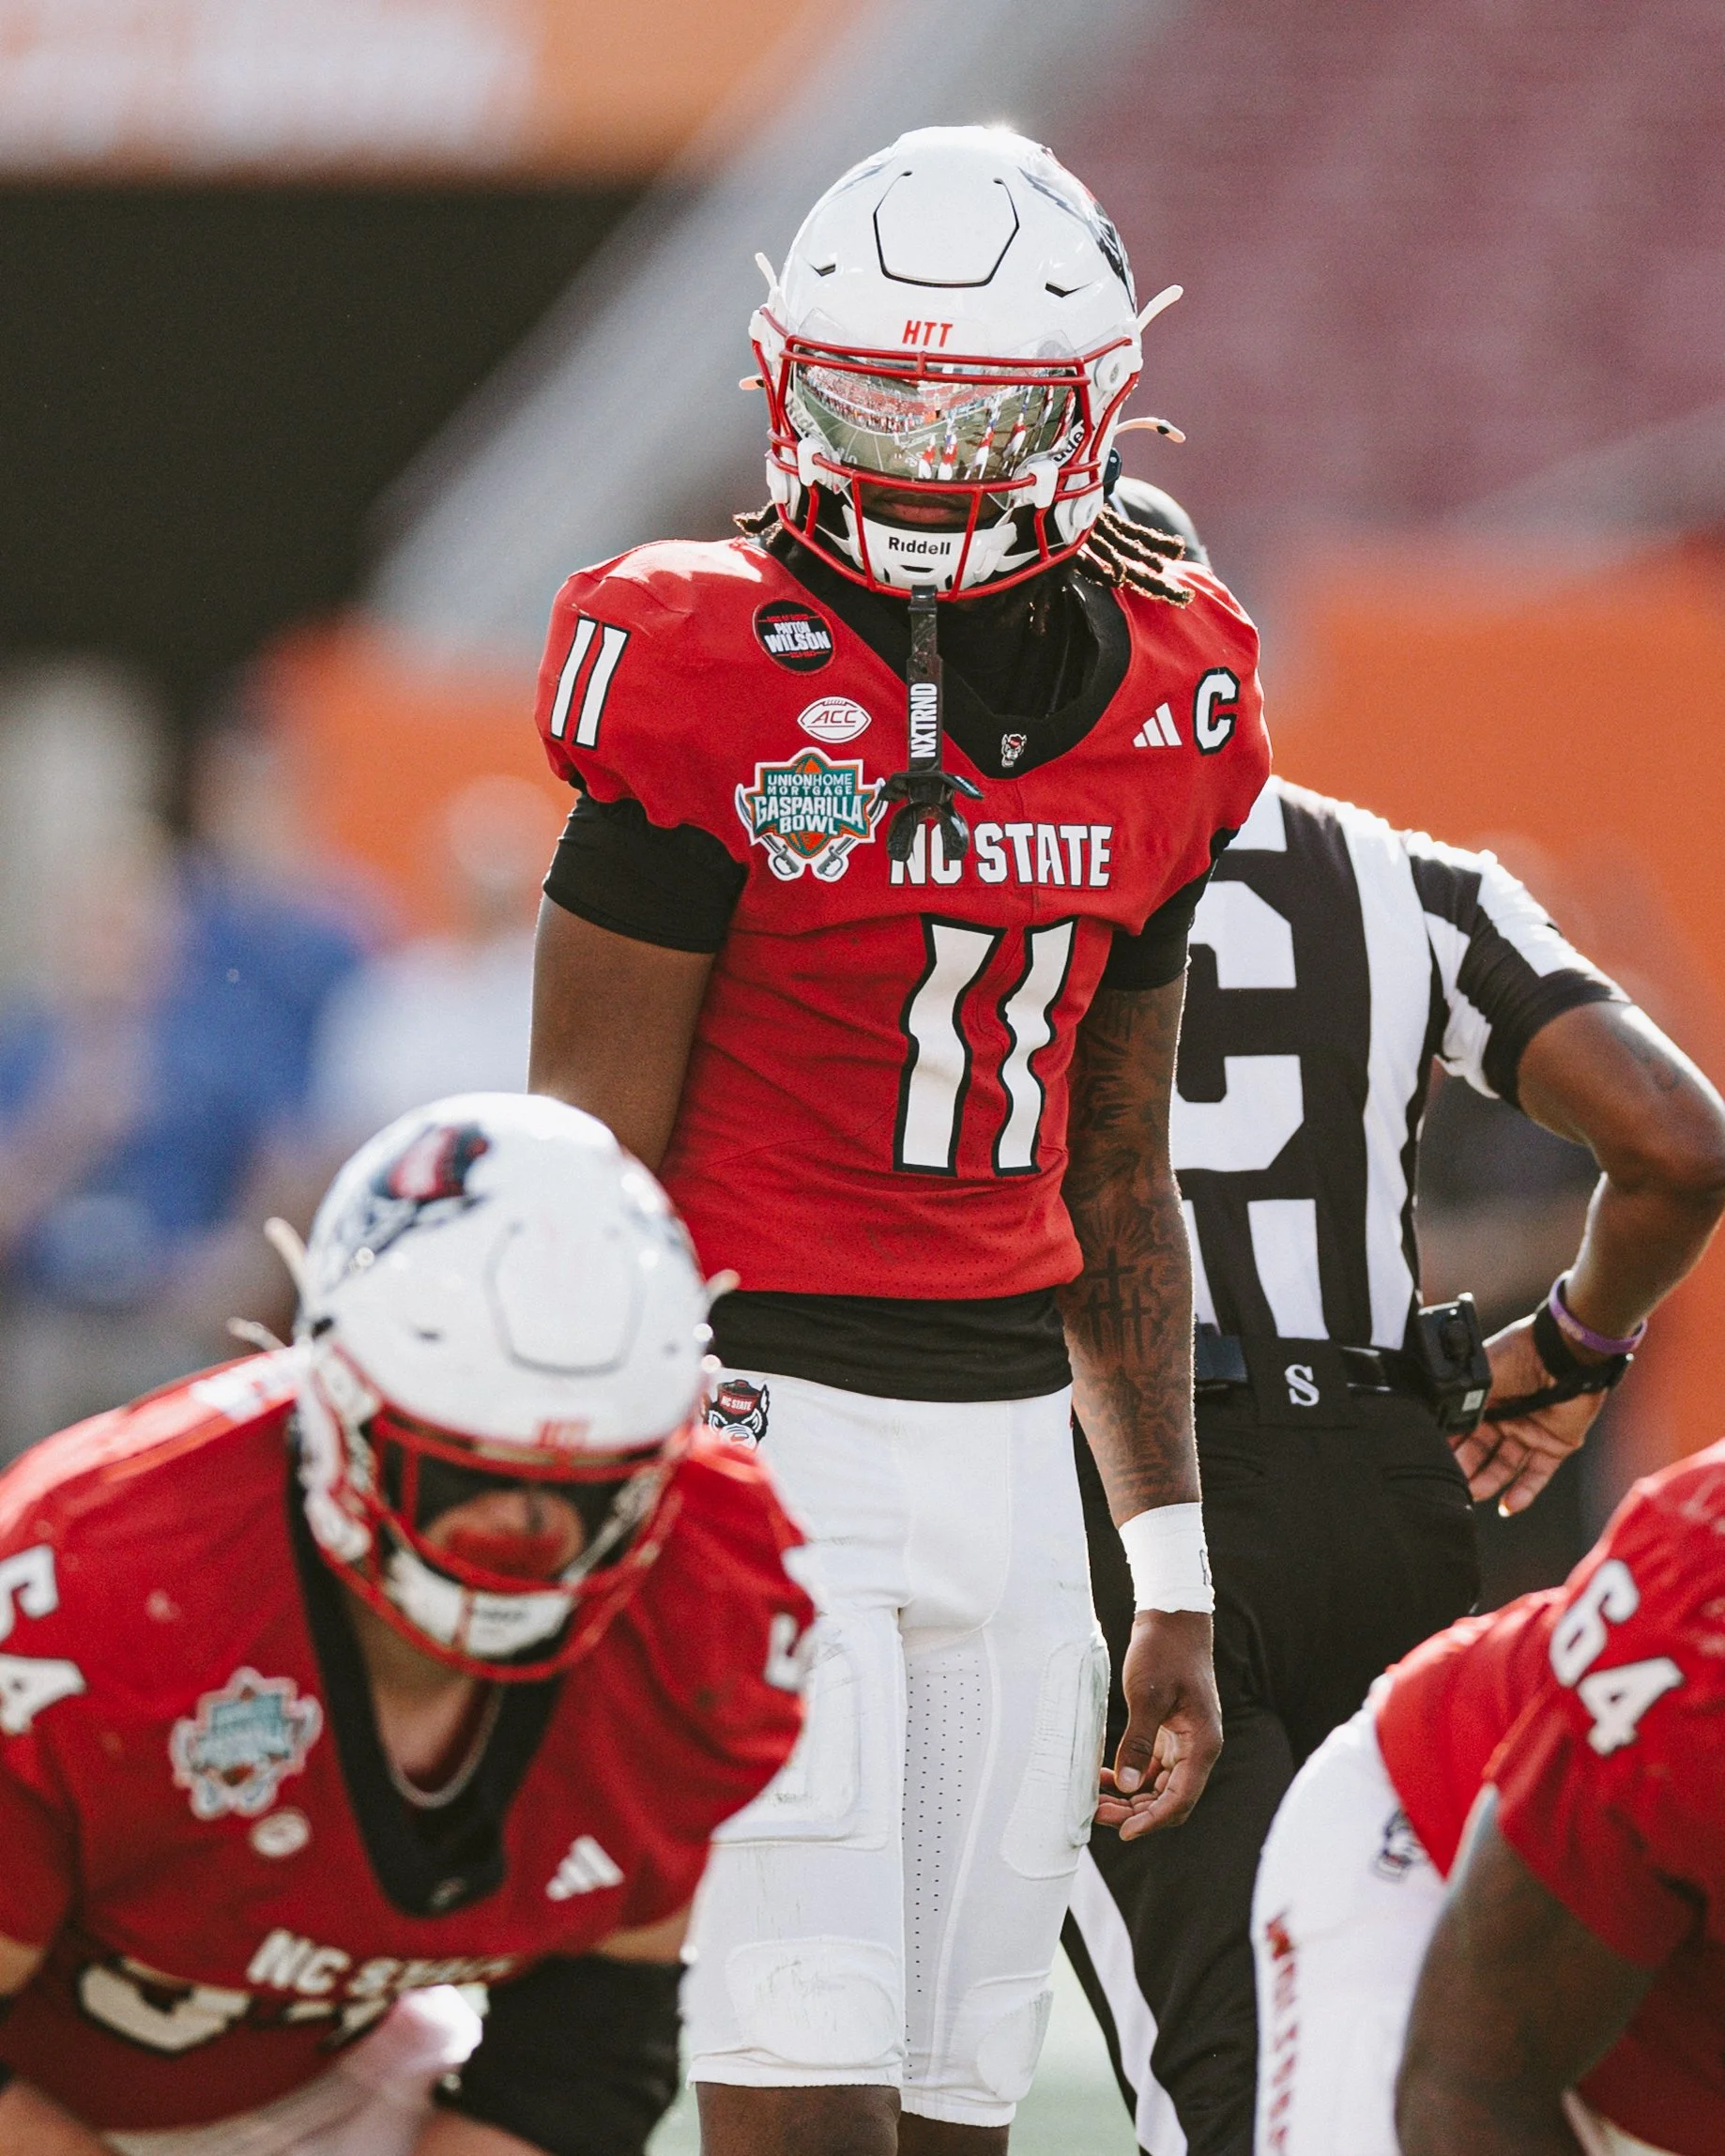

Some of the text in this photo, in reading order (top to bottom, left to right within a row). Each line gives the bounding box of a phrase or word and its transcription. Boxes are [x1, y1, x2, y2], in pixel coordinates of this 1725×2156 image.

[902, 319, 954, 347] HTT
[888, 536, 951, 556] Riddell
[763, 631, 832, 653] WILSON
[550, 616, 631, 751] 11
[811, 710, 859, 724] ACC
[909, 682, 939, 758] NXTRND
[1193, 666, 1240, 755] C
[767, 772, 853, 787] UNIONHOME
[767, 786, 853, 795] MORTGAGE
[754, 795, 864, 831] GASPARILLA
[779, 814, 838, 835] BOWL
[973, 822, 1113, 887] STATE
[893, 912, 1079, 1177] 11
[1285, 1364, 1320, 1406] S
[1549, 1558, 1686, 1756] 64
[246, 1927, 352, 1996] NC
